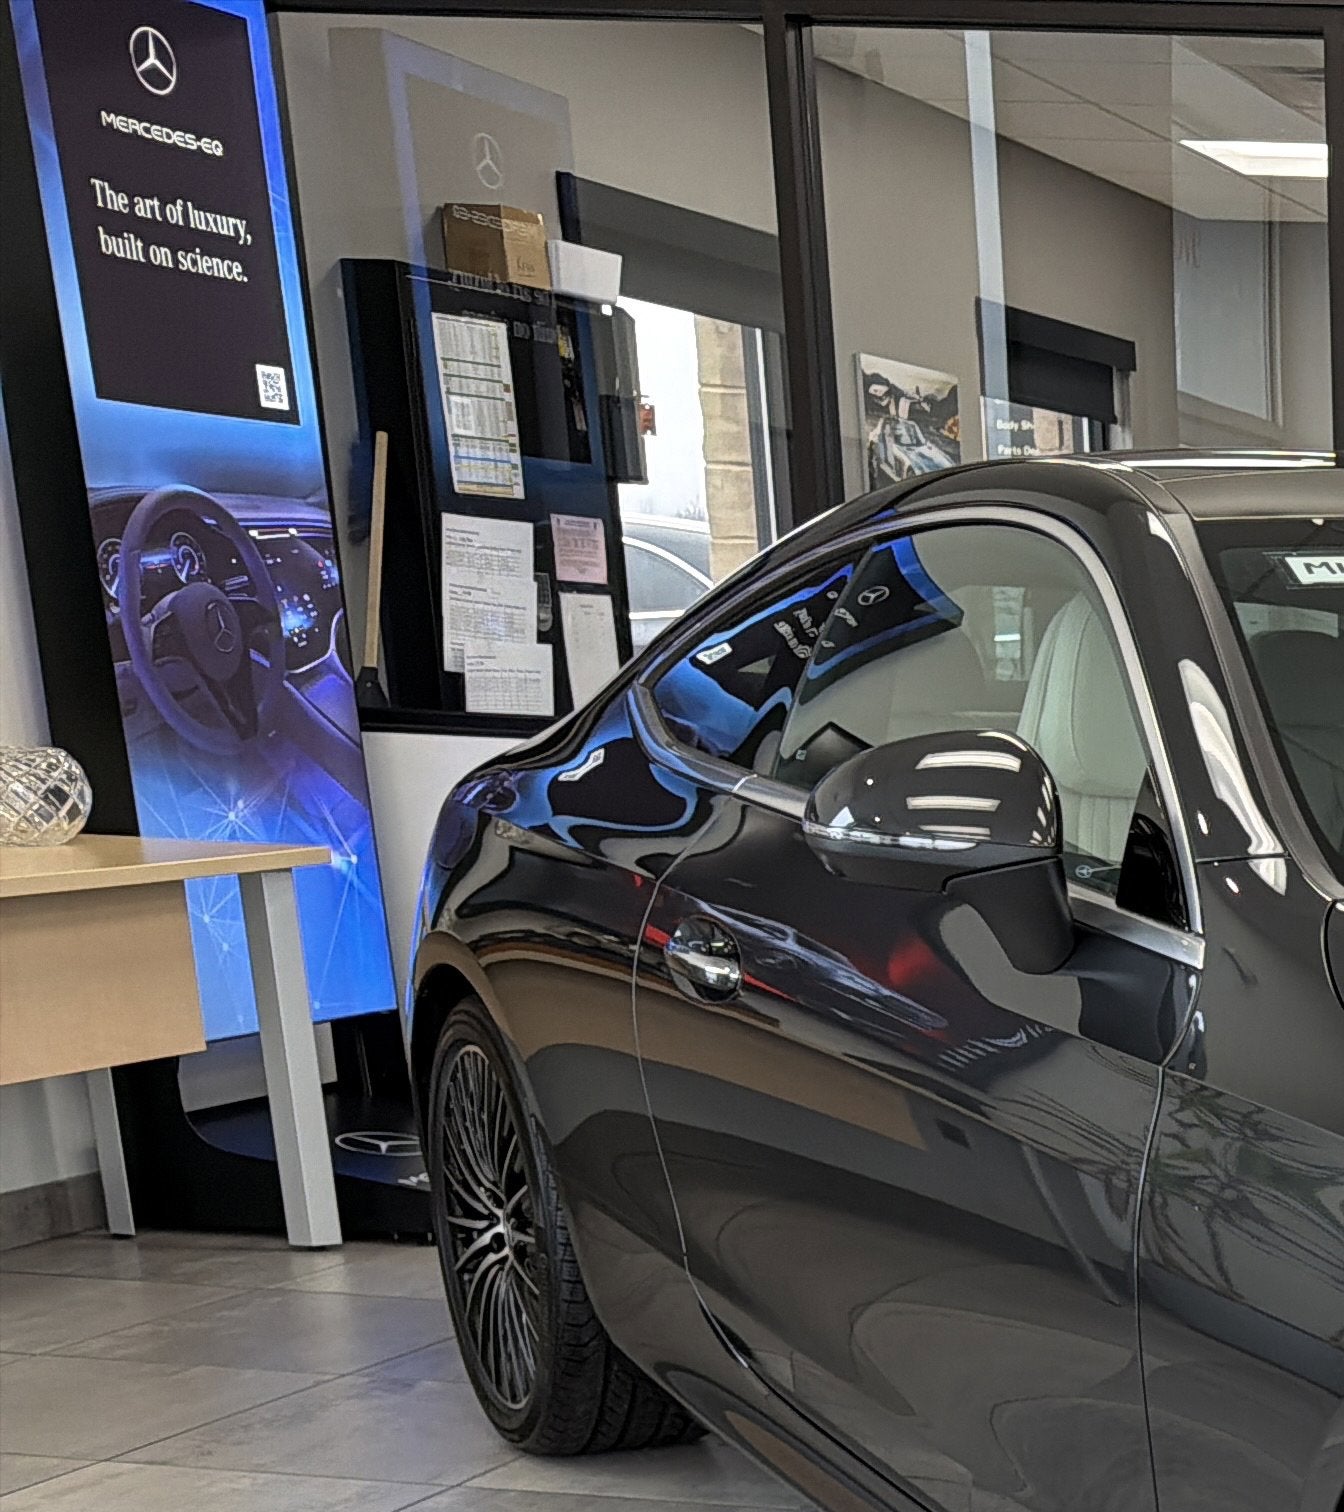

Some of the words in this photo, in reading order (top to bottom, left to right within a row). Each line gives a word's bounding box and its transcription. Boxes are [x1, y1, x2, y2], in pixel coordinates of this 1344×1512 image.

[100, 110, 224, 157] MERCEDES-EQ
[90, 177, 130, 214] The
[133, 196, 163, 222] art
[166, 199, 185, 227] of
[187, 201, 252, 246] luxury,
[97, 226, 147, 263] built
[149, 244, 175, 269] on
[178, 247, 249, 283] science.
